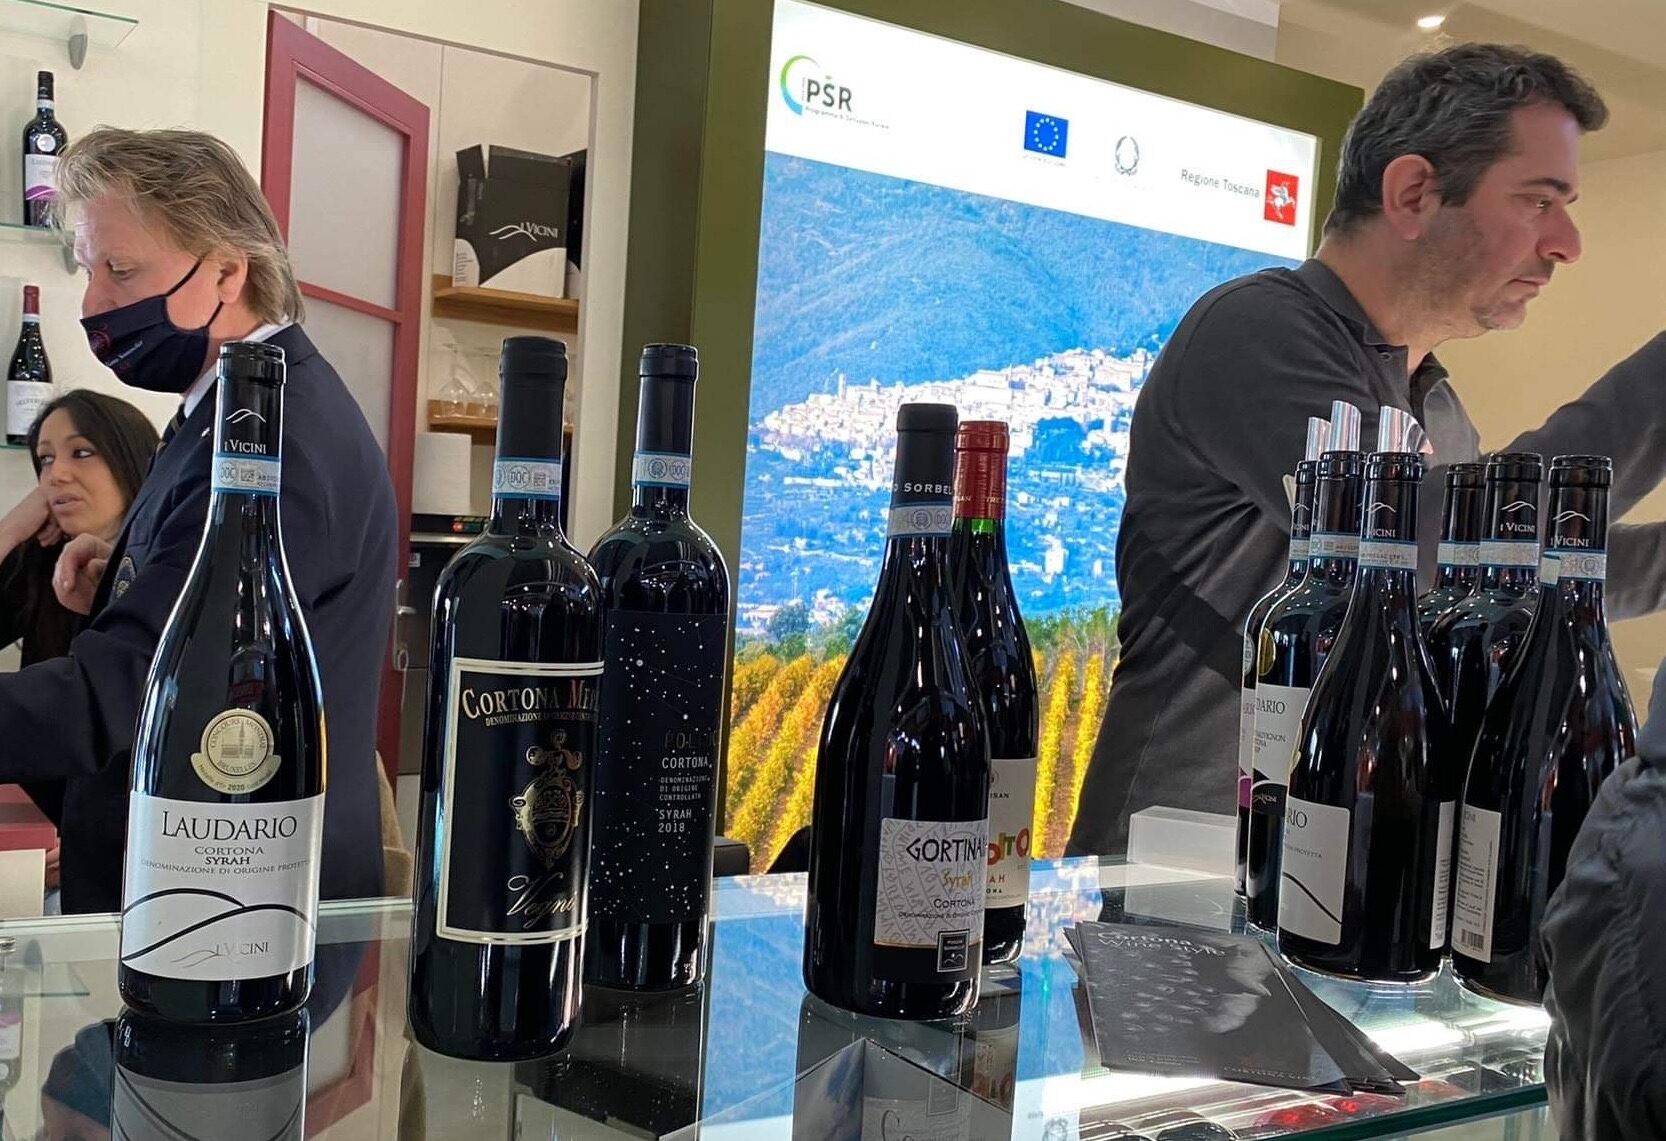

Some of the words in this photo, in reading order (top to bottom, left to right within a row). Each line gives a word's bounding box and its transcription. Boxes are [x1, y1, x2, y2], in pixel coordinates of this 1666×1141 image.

[806, 78, 852, 112] PSR
[1181, 168, 1220, 187] Regione
[1223, 178, 1260, 198] Toscana
[229, 439, 267, 454] VICINI
[1506, 522, 1535, 533] VICINI
[1555, 535, 1590, 547] VICINI
[462, 688, 560, 719] CORTONA
[662, 756, 708, 769] CORTONA
[227, 783, 245, 791] 2020
[659, 809, 692, 820] SYRAH
[162, 811, 298, 841] LAUDARIO
[658, 822, 685, 833] 2018
[194, 846, 265, 856] CORTONA
[906, 837, 987, 862] GORTINA
[141, 858, 216, 875] DENOMINAZIONE
[219, 867, 230, 875] DI
[234, 866, 275, 875] ORIGINE
[277, 859, 311, 871] PROTETT
[205, 856, 251, 865] SYRAH
[224, 942, 268, 956] VCINI
